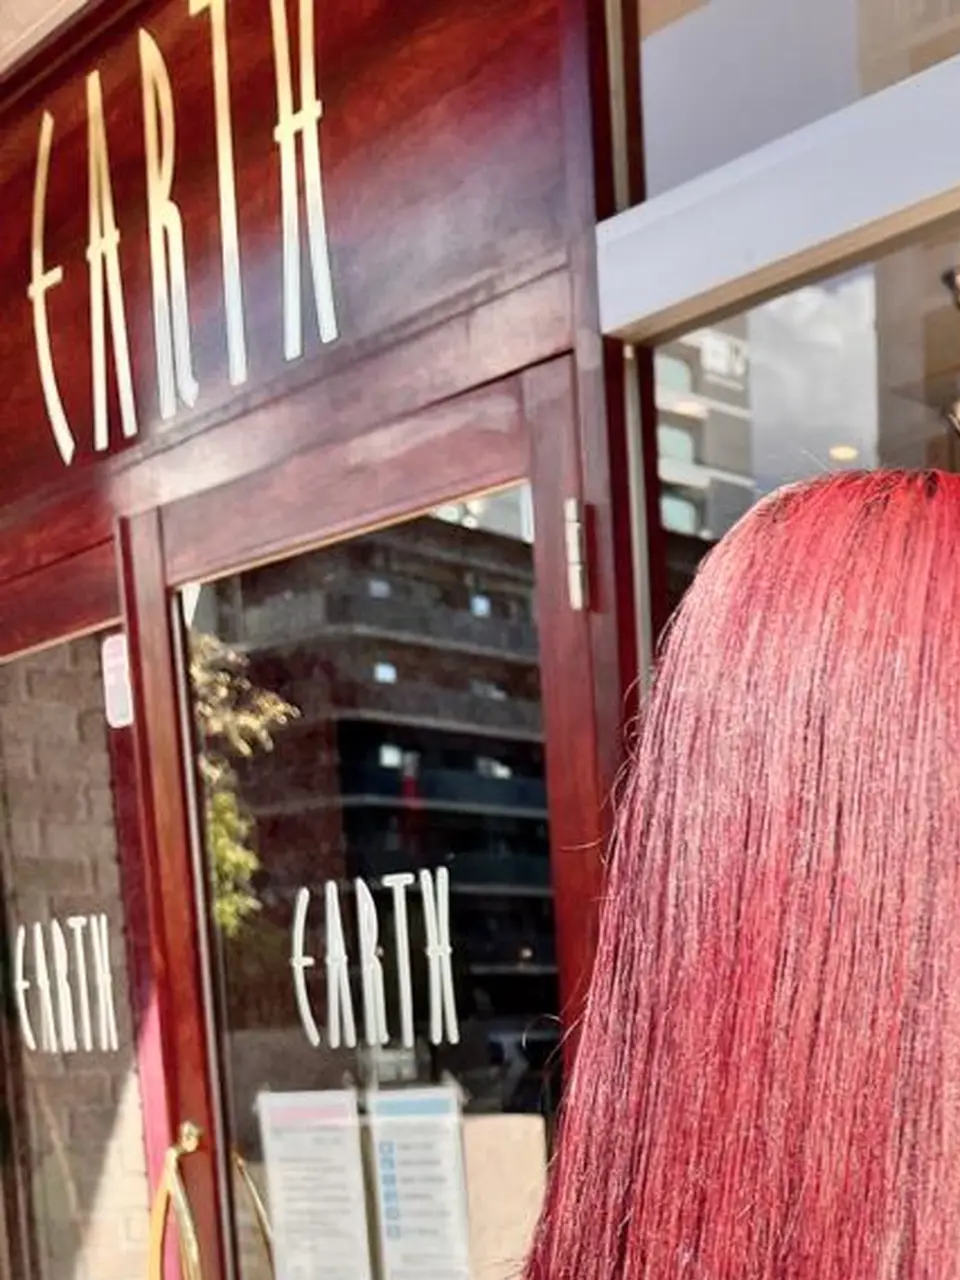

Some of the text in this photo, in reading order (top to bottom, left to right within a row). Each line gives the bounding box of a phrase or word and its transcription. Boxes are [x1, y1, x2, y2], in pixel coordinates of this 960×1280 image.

[27, 0, 339, 466] EARTH
[14, 914, 118, 1053] EARTH
[290, 866, 459, 1049] EARTH
